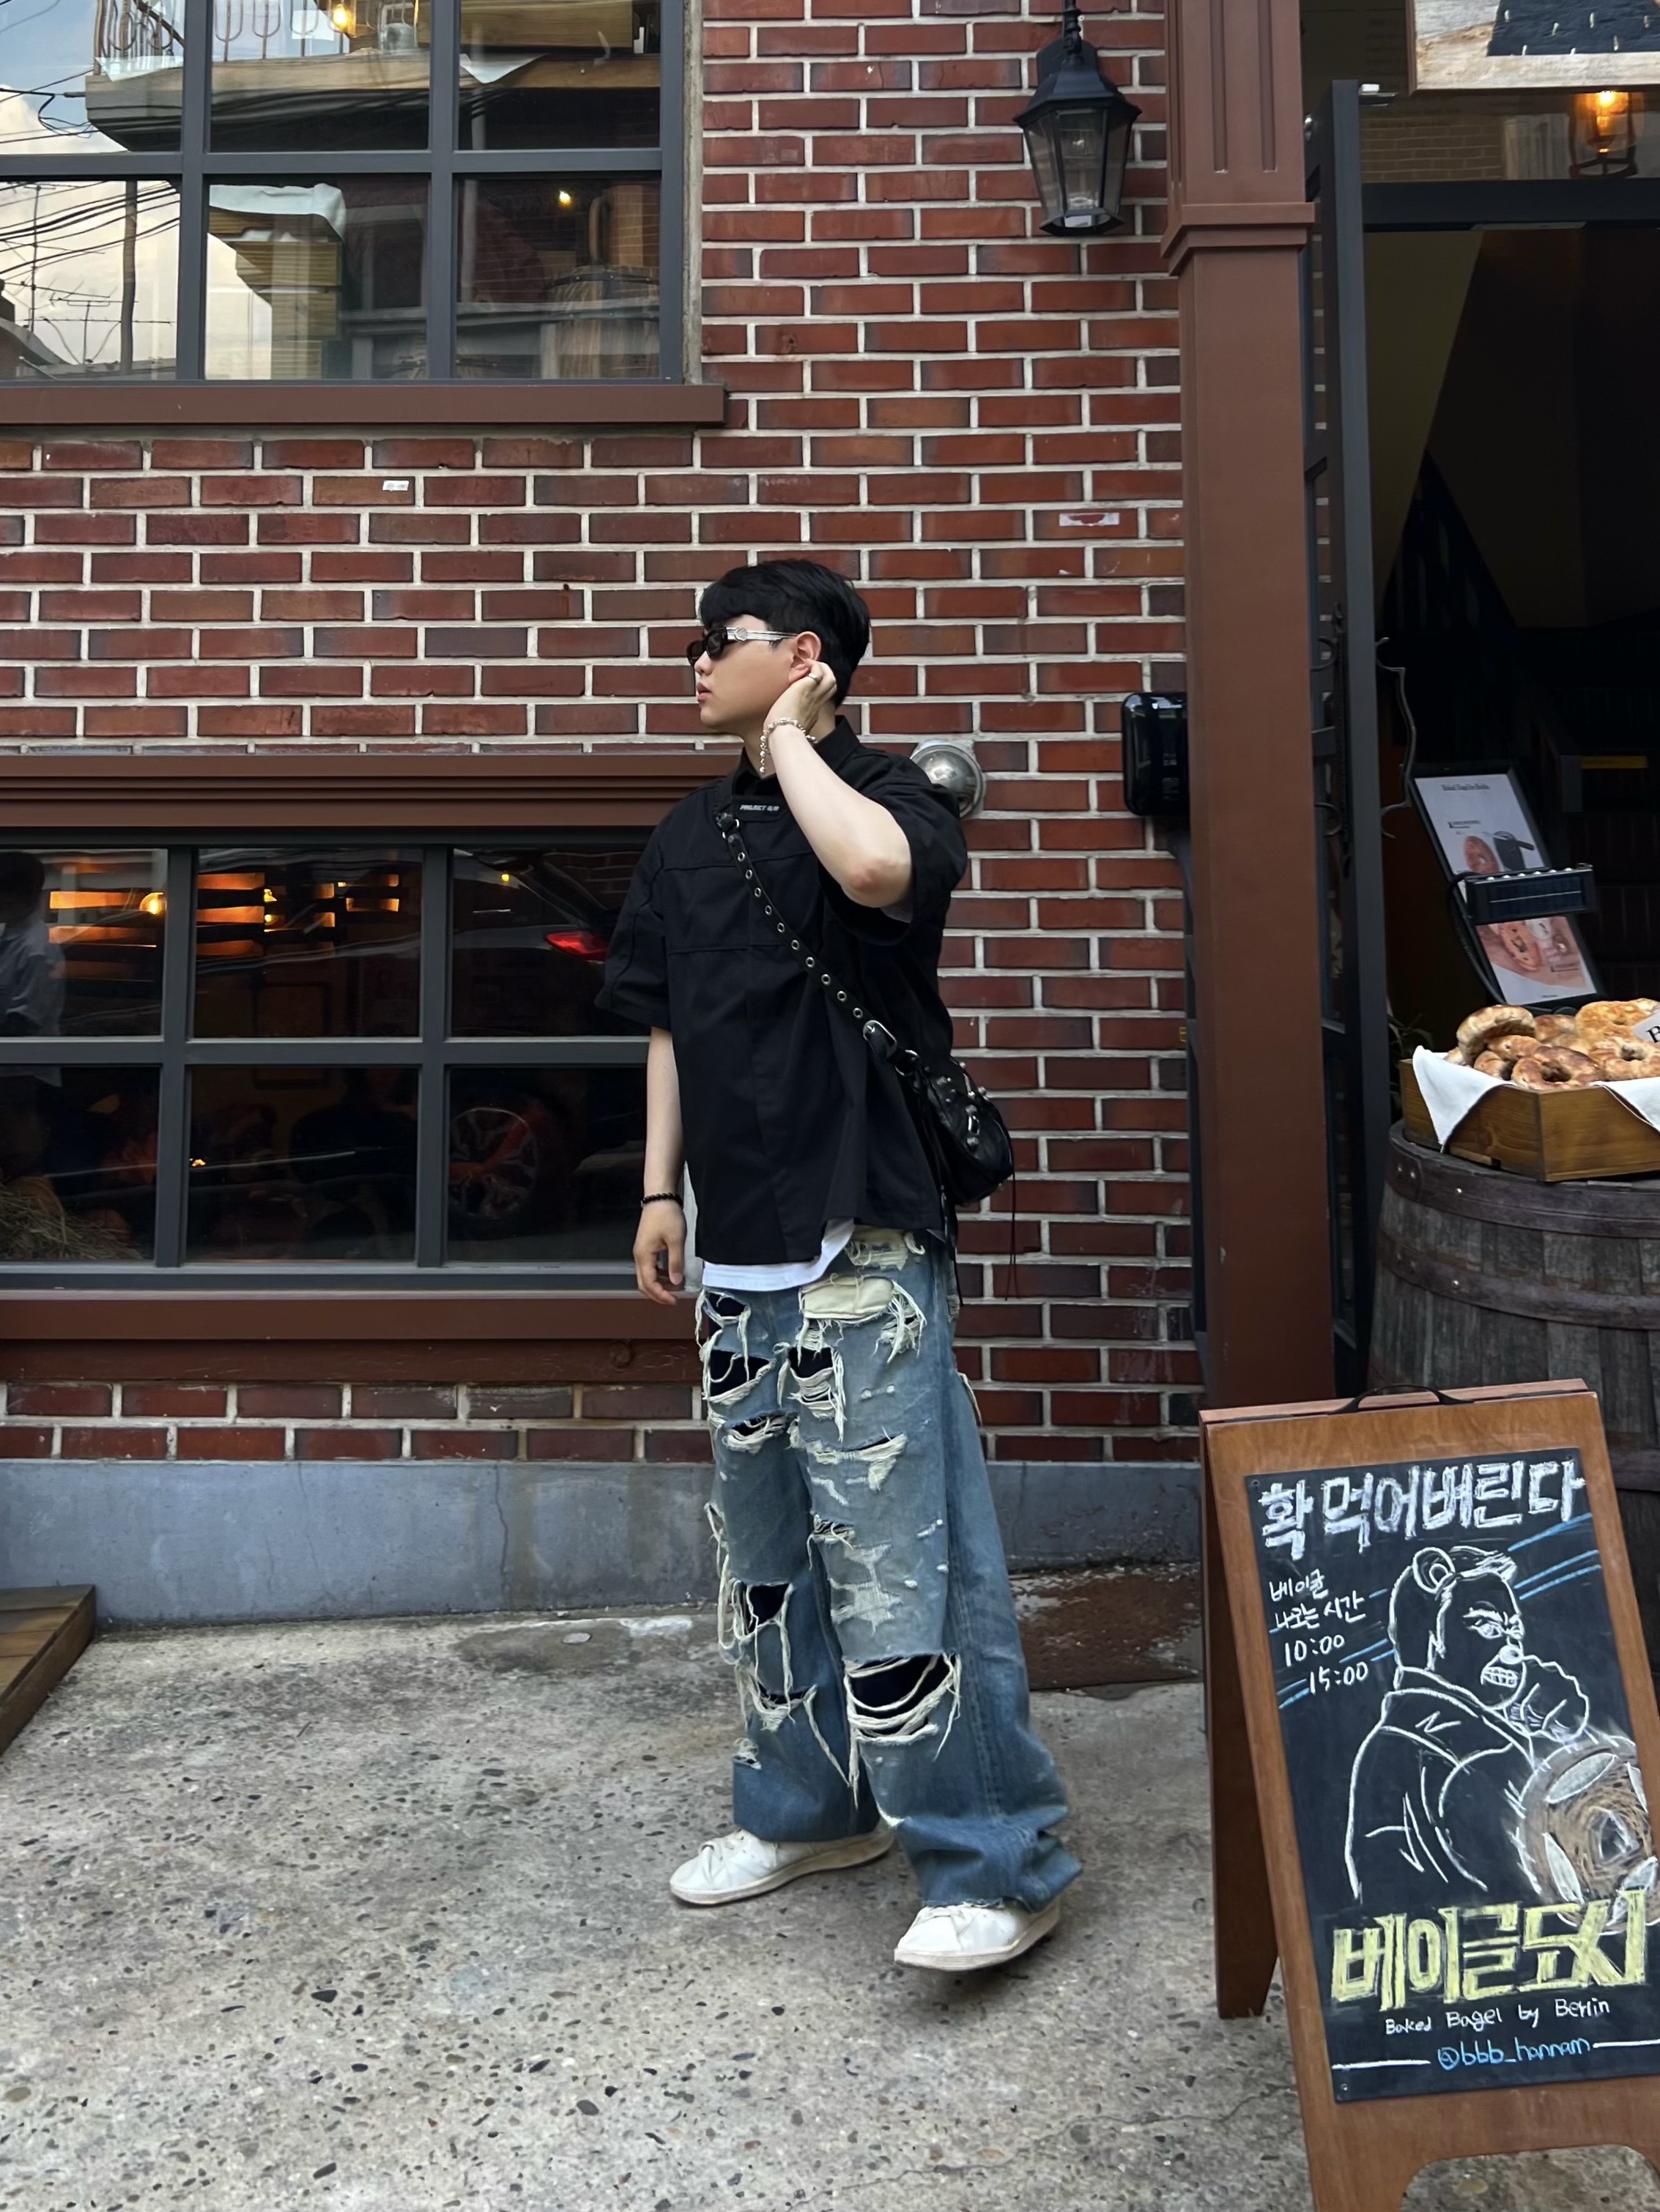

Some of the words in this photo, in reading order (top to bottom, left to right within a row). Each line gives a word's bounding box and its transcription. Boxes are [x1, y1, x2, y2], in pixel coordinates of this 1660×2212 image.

[1259, 1480, 1313, 1561] 확
[1322, 1461, 1585, 1554] 먹어버린다
[1269, 1568, 1329, 1602] 베이글
[1275, 1603, 1320, 1630] 나오는
[1323, 1589, 1366, 1623] 시간
[1284, 1634, 1345, 1667] 10:00
[1310, 1661, 1368, 1696] 15:00
[1385, 2016, 1432, 2035] Baked
[1446, 2007, 1502, 2032] Bagel
[1519, 2004, 1538, 2028] by
[1555, 1997, 1610, 2018] Berlin
[1438, 2037, 1591, 2071] @bbb_hannam
